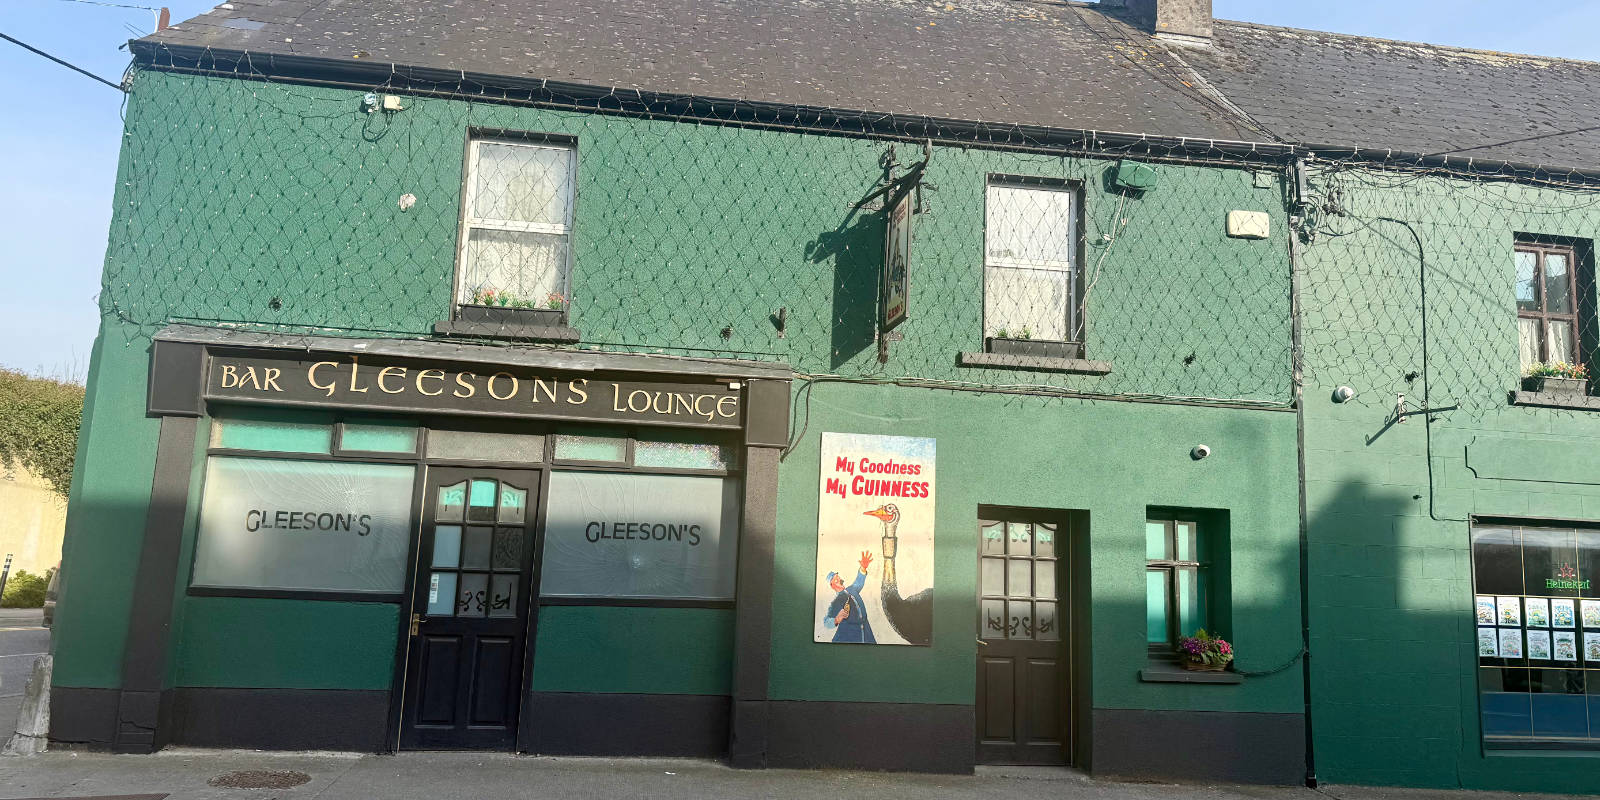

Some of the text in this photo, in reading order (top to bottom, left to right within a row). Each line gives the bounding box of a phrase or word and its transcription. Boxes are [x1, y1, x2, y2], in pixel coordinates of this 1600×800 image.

[221, 356, 739, 422] BAR GLEESONS LOUNGE
[836, 456, 921, 476] My Goodness
[826, 475, 929, 499] My GUINNESS
[246, 509, 372, 536] GLEESON'S
[585, 521, 701, 546] GLEESON'S
